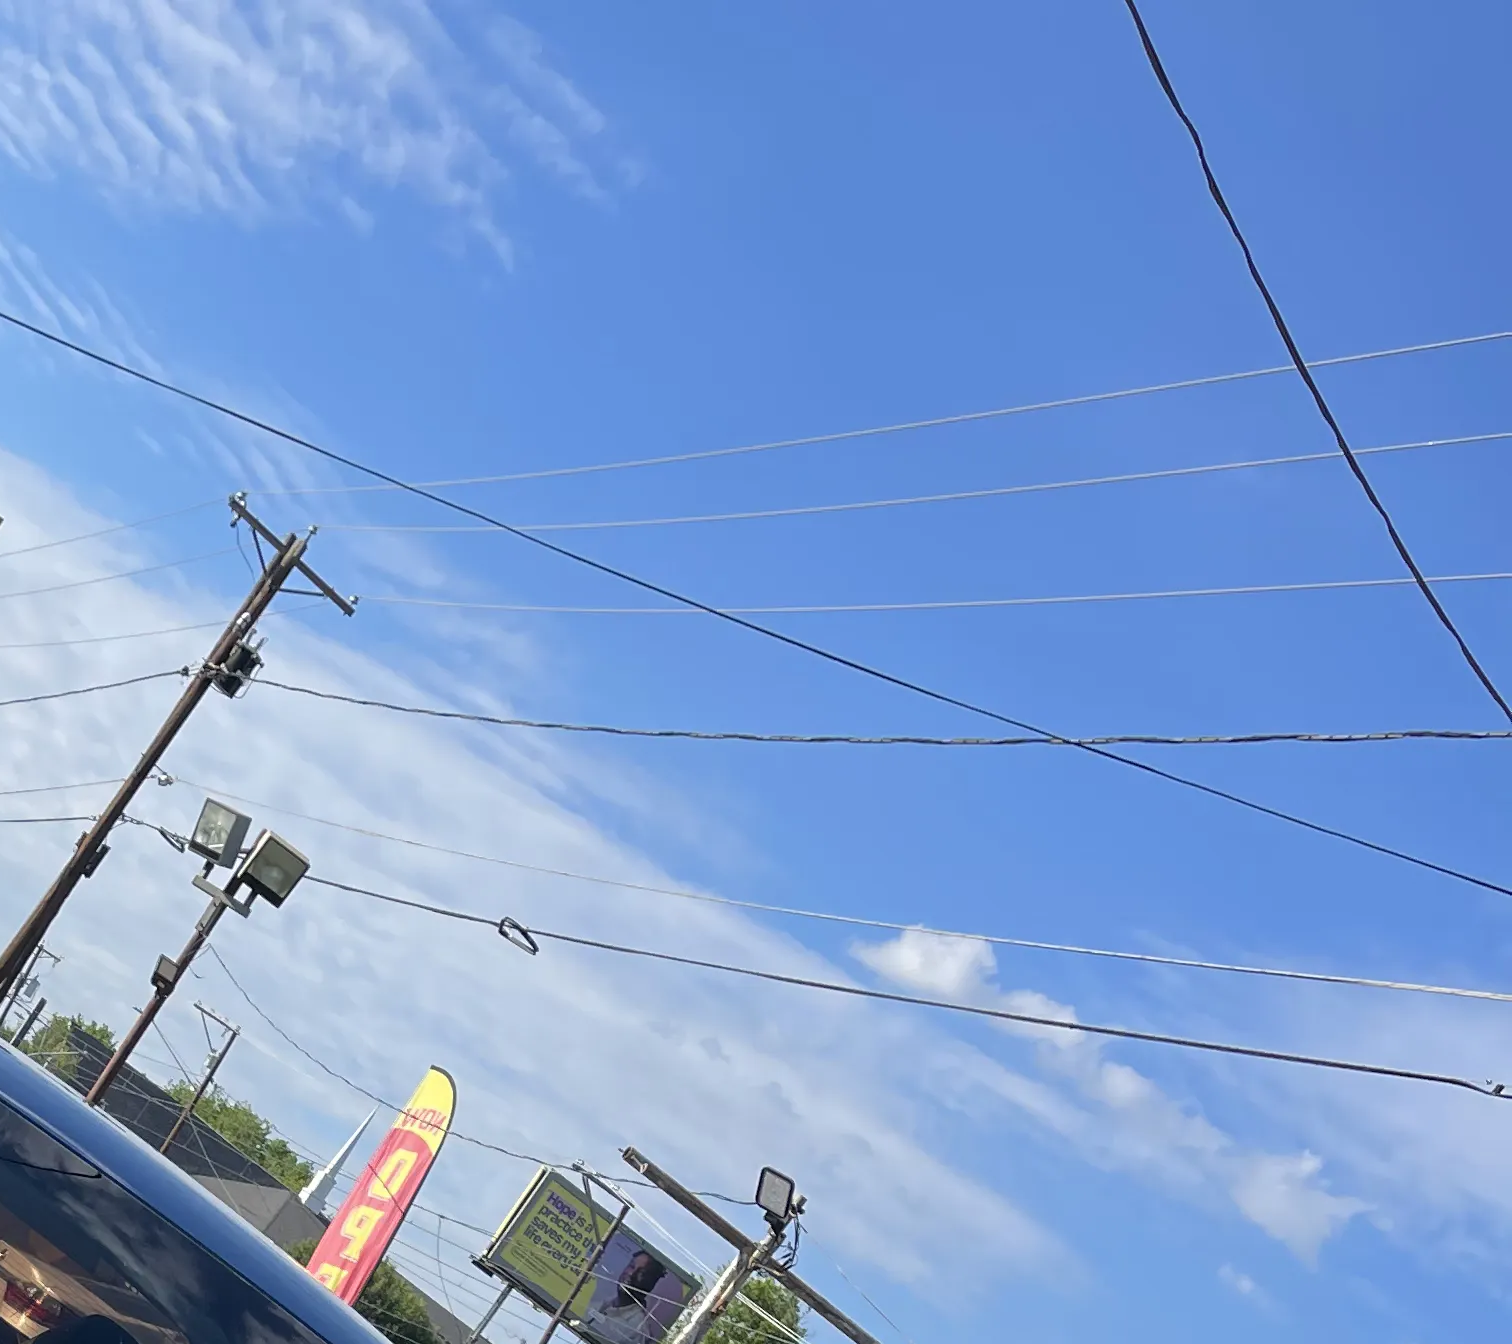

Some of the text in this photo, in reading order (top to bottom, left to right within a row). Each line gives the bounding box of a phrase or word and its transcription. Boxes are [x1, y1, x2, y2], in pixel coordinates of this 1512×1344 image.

[538, 1205, 583, 1242] practice
[547, 1191, 577, 1220] Hope
[575, 1212, 587, 1228] is
[523, 1224, 542, 1245] life
[531, 1215, 582, 1259] saves my
